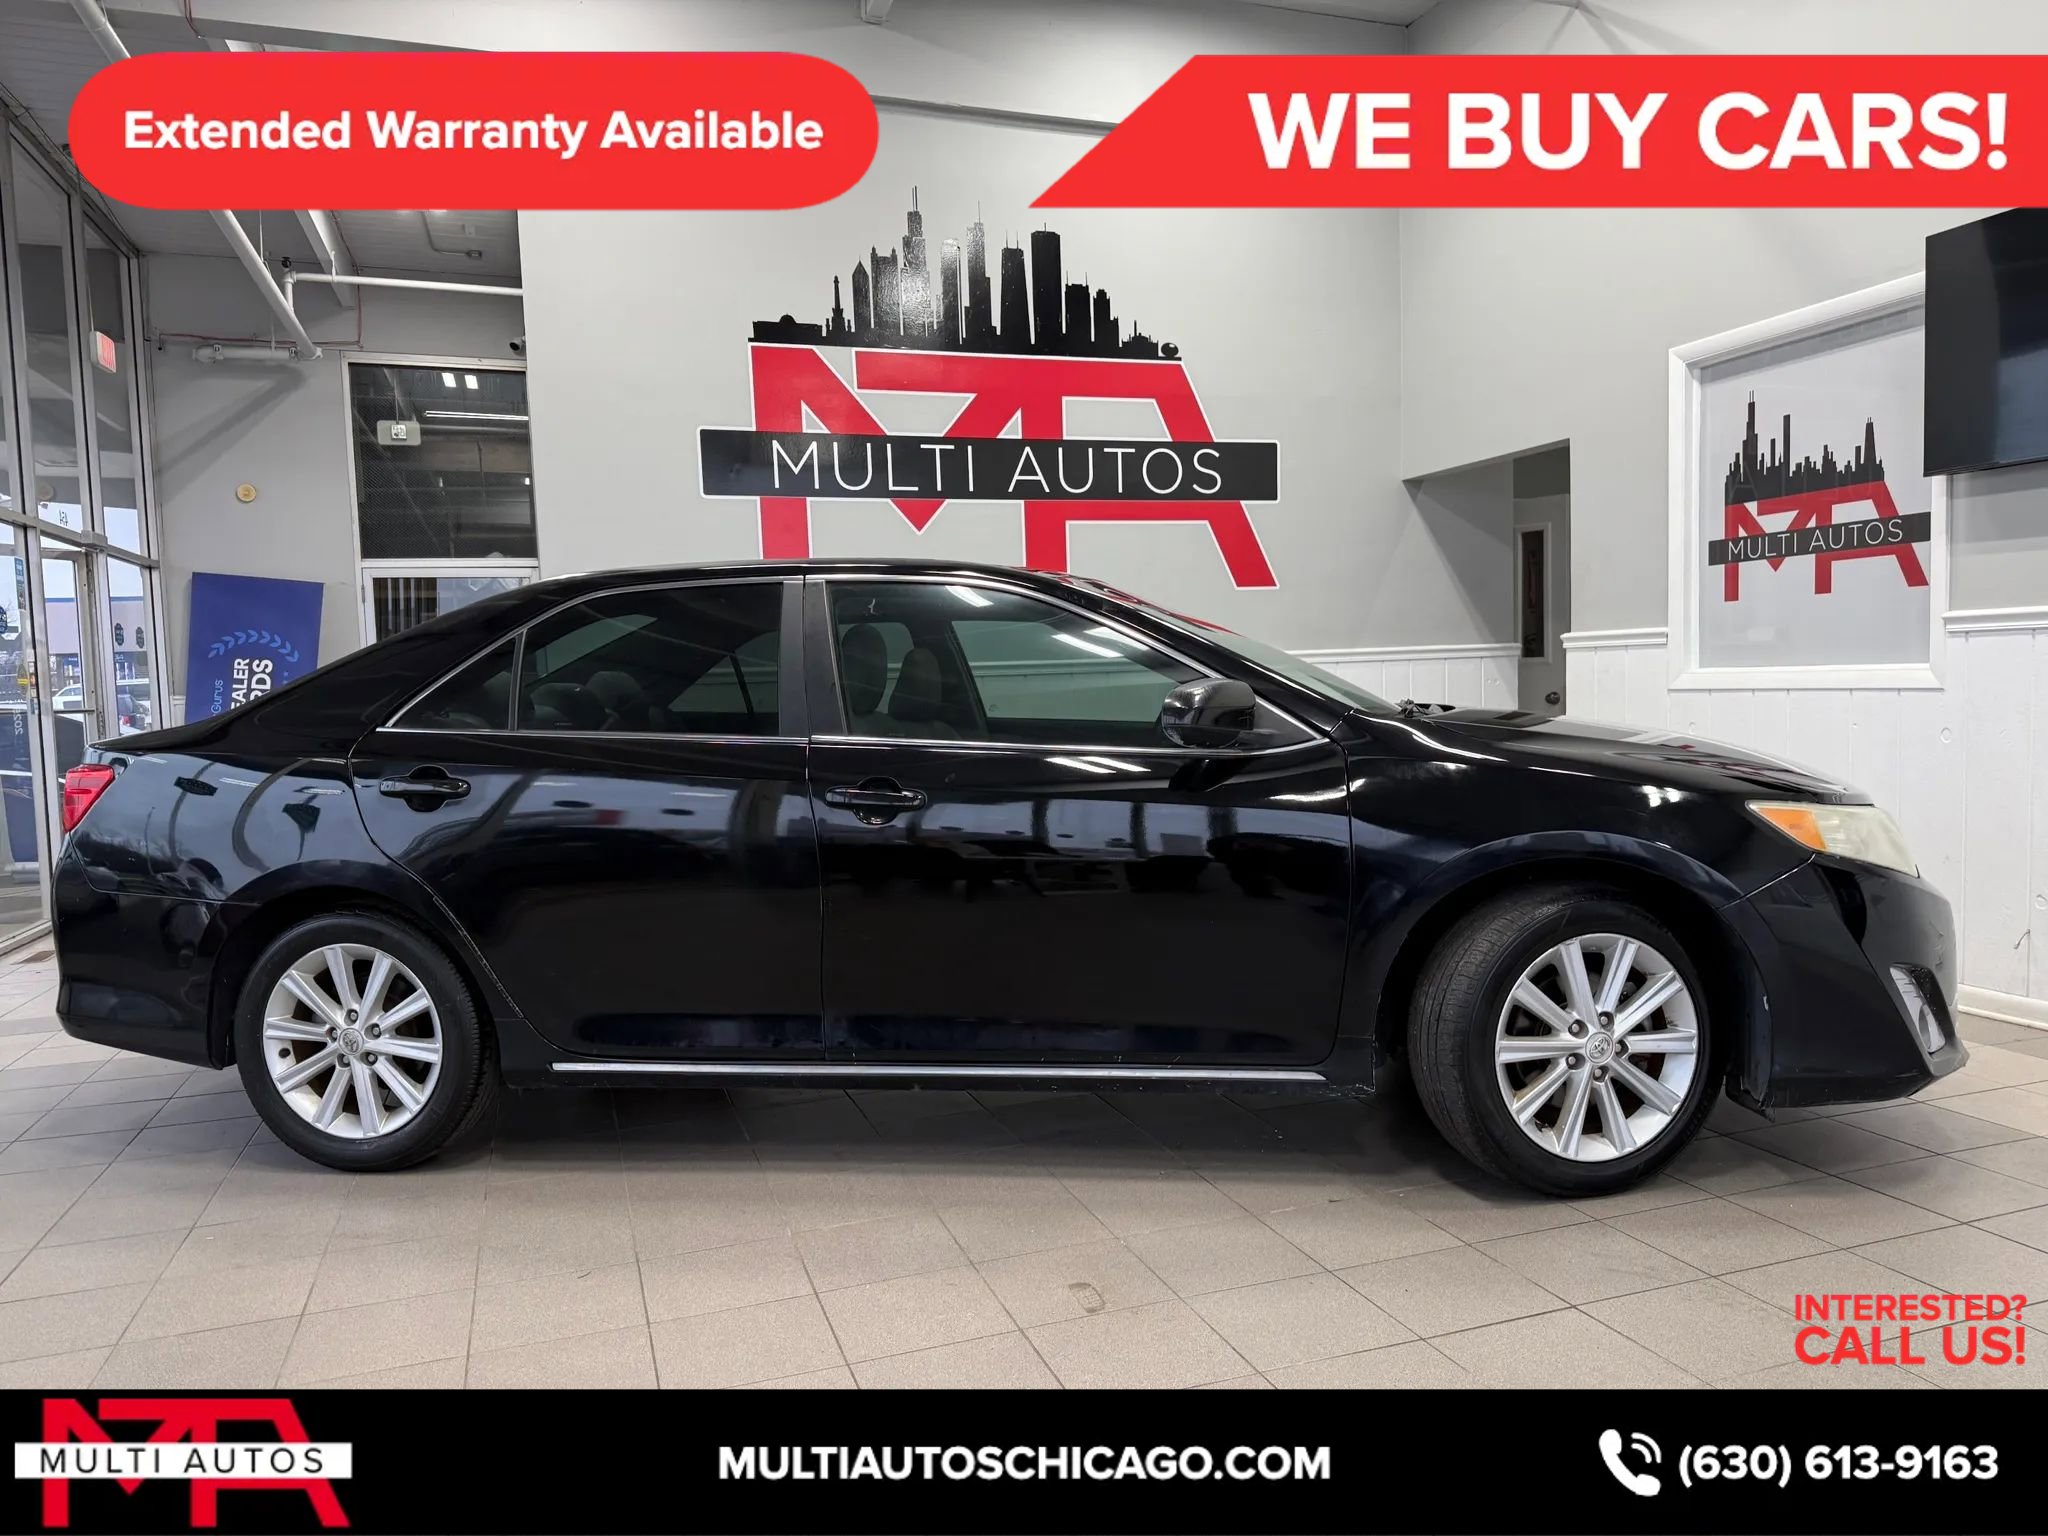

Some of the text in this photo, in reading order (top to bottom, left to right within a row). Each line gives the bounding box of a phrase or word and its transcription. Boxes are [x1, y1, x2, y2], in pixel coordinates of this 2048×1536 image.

[771, 439, 1222, 495] MULTI AUTOS
[1727, 518, 1904, 561] MULTI AUTOS
